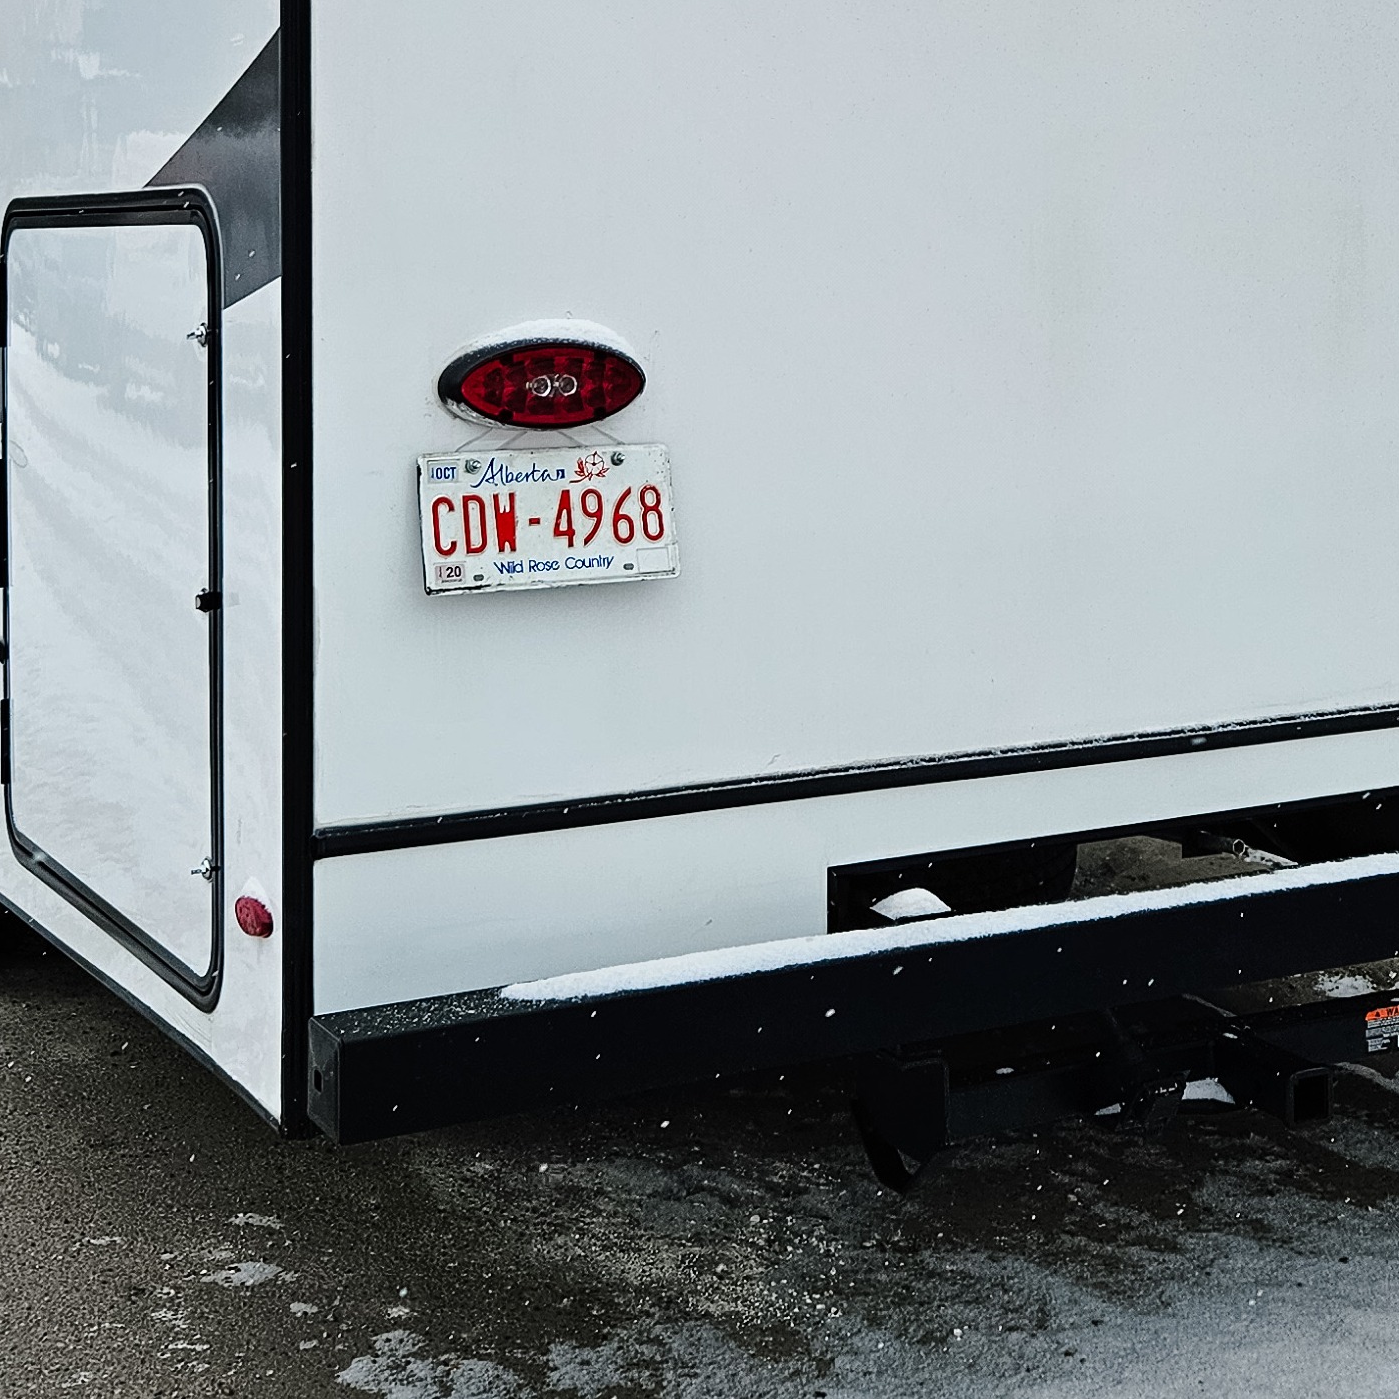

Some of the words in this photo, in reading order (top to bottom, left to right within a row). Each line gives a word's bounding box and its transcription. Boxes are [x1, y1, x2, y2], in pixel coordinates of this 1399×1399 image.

[434, 466, 457, 480] OCT
[470, 457, 565, 489] Alberta
[431, 484, 665, 556] CDW-4968
[445, 565, 462, 579] 20
[493, 560, 524, 575] Wild
[528, 557, 561, 573] Rose
[564, 554, 615, 572] Country
